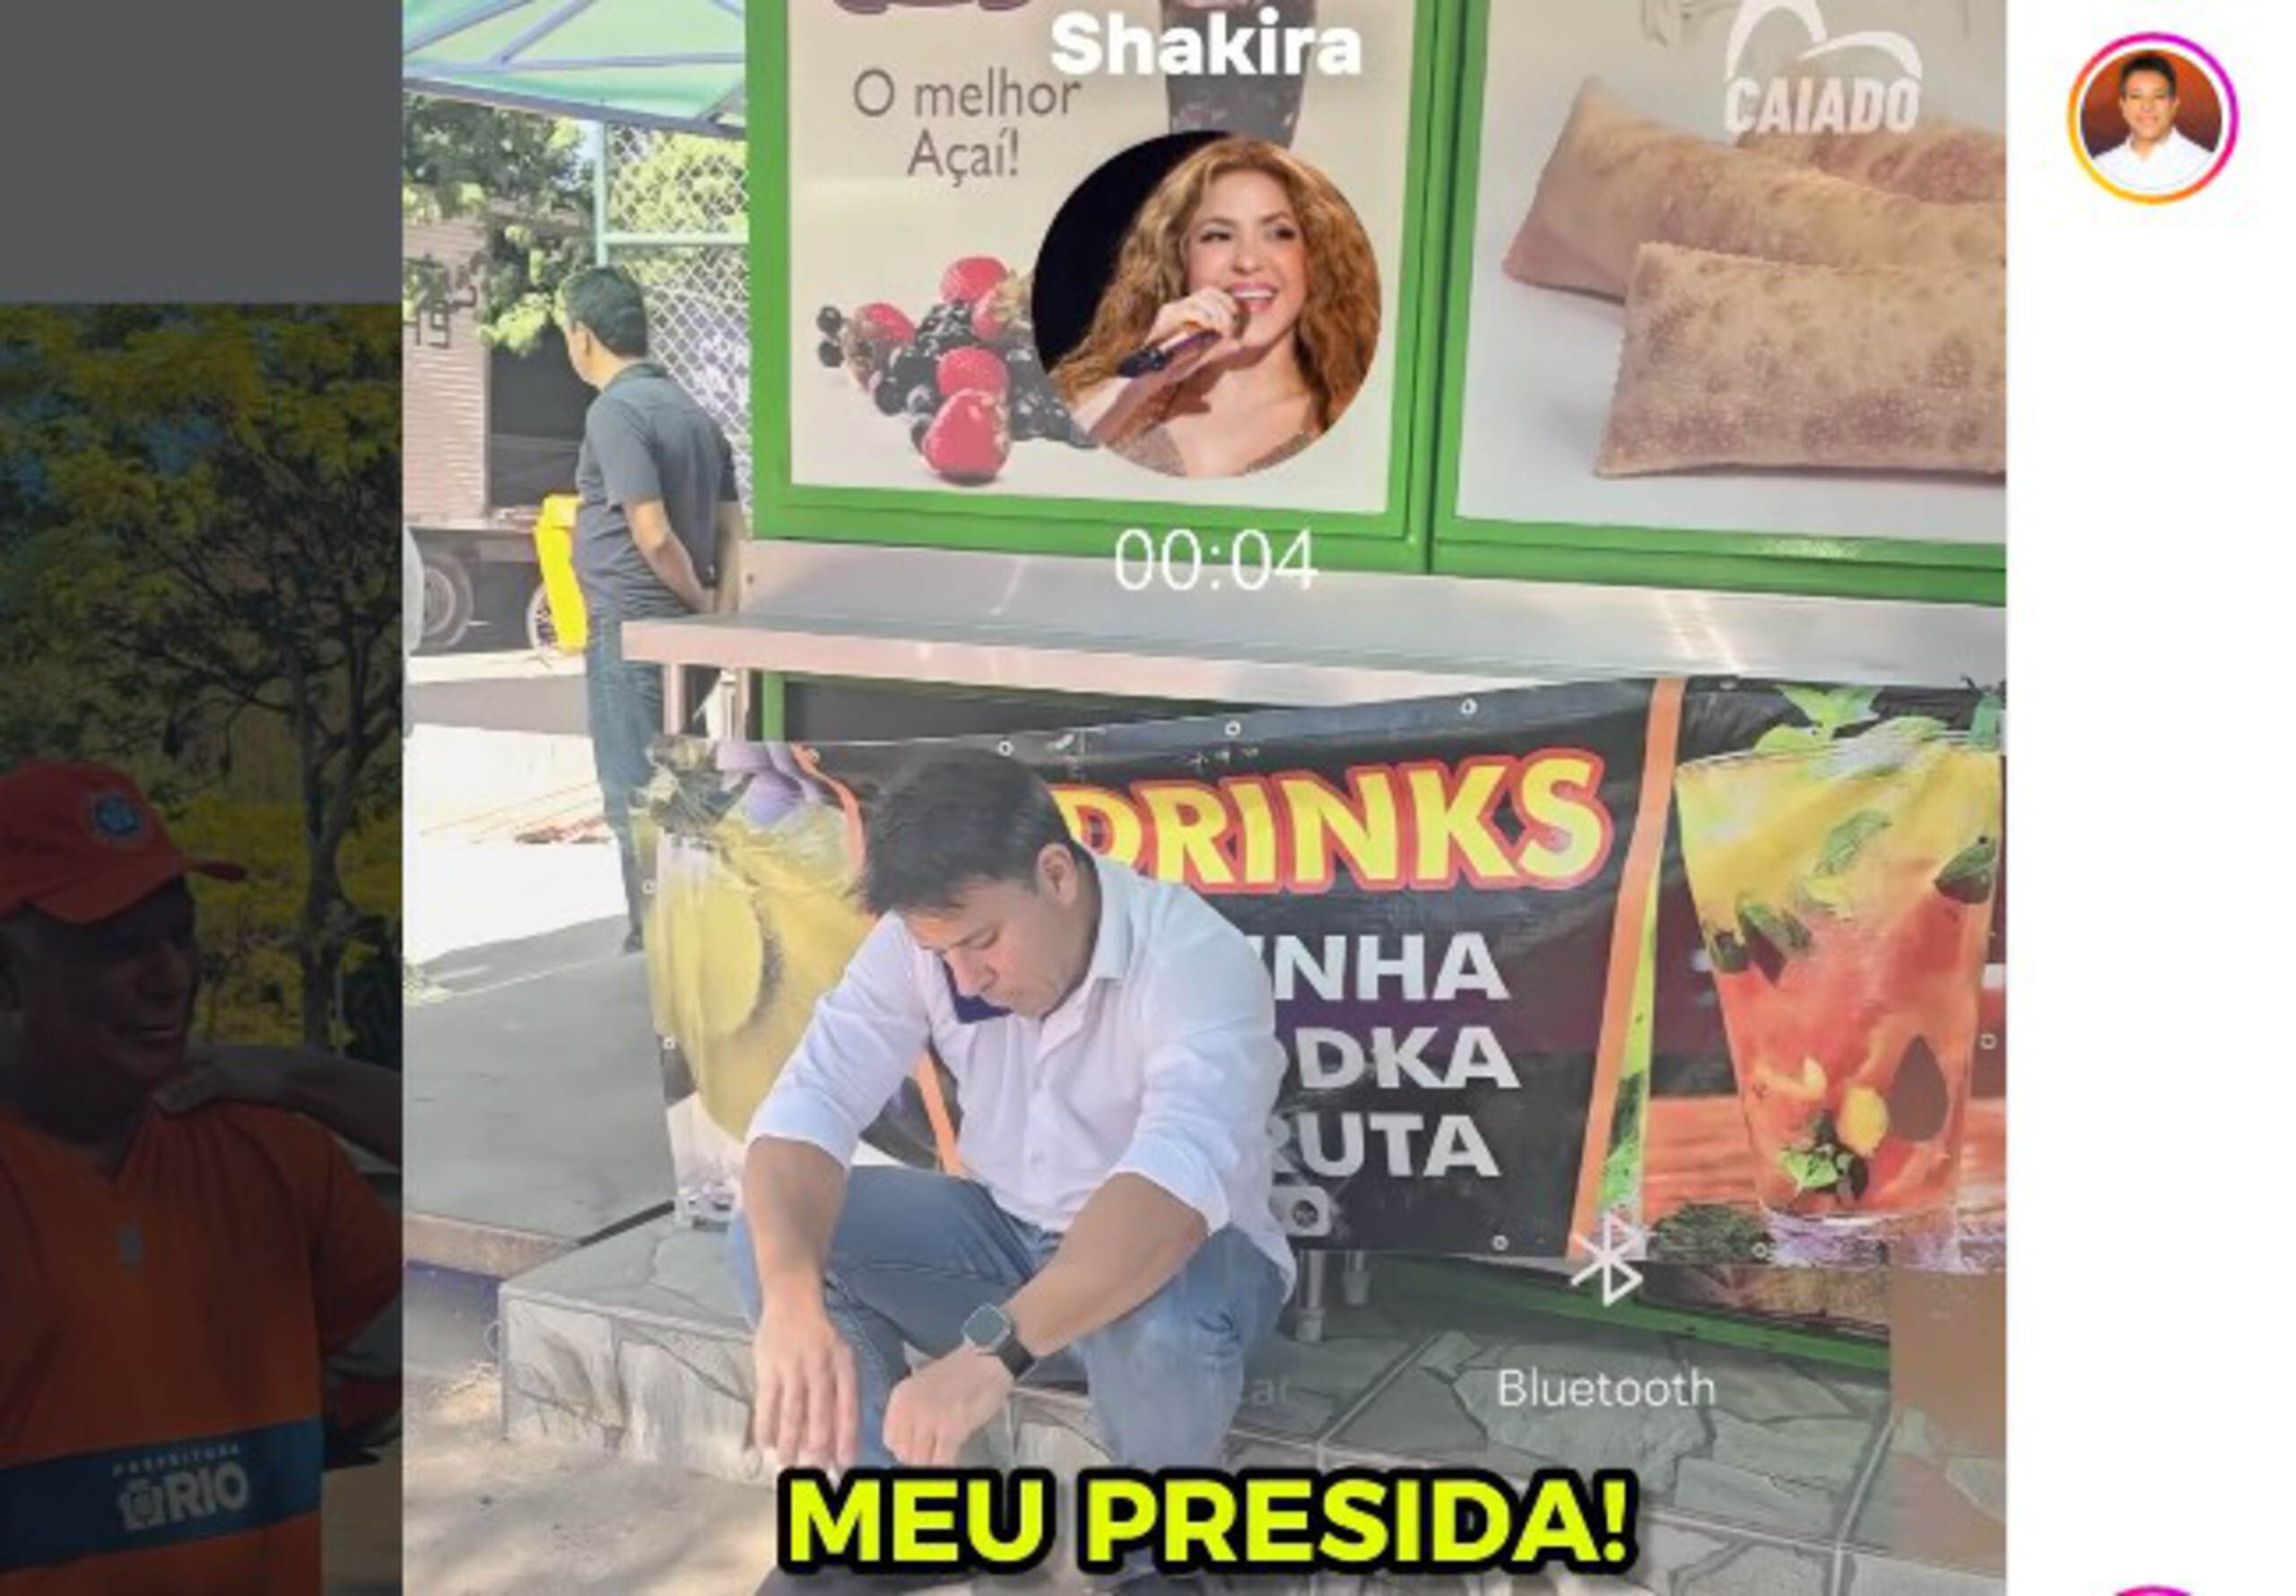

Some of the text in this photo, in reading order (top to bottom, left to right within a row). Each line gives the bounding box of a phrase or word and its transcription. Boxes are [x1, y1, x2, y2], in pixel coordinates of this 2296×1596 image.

[854, 65, 1082, 117] O melhor
[906, 126, 1019, 187] Açaí!
[1045, 750, 1613, 890] DRINKS
[1247, 932, 1510, 1002] NHA
[1277, 1025, 1521, 1089] DKA
[163, 1462, 249, 1522] RIO
